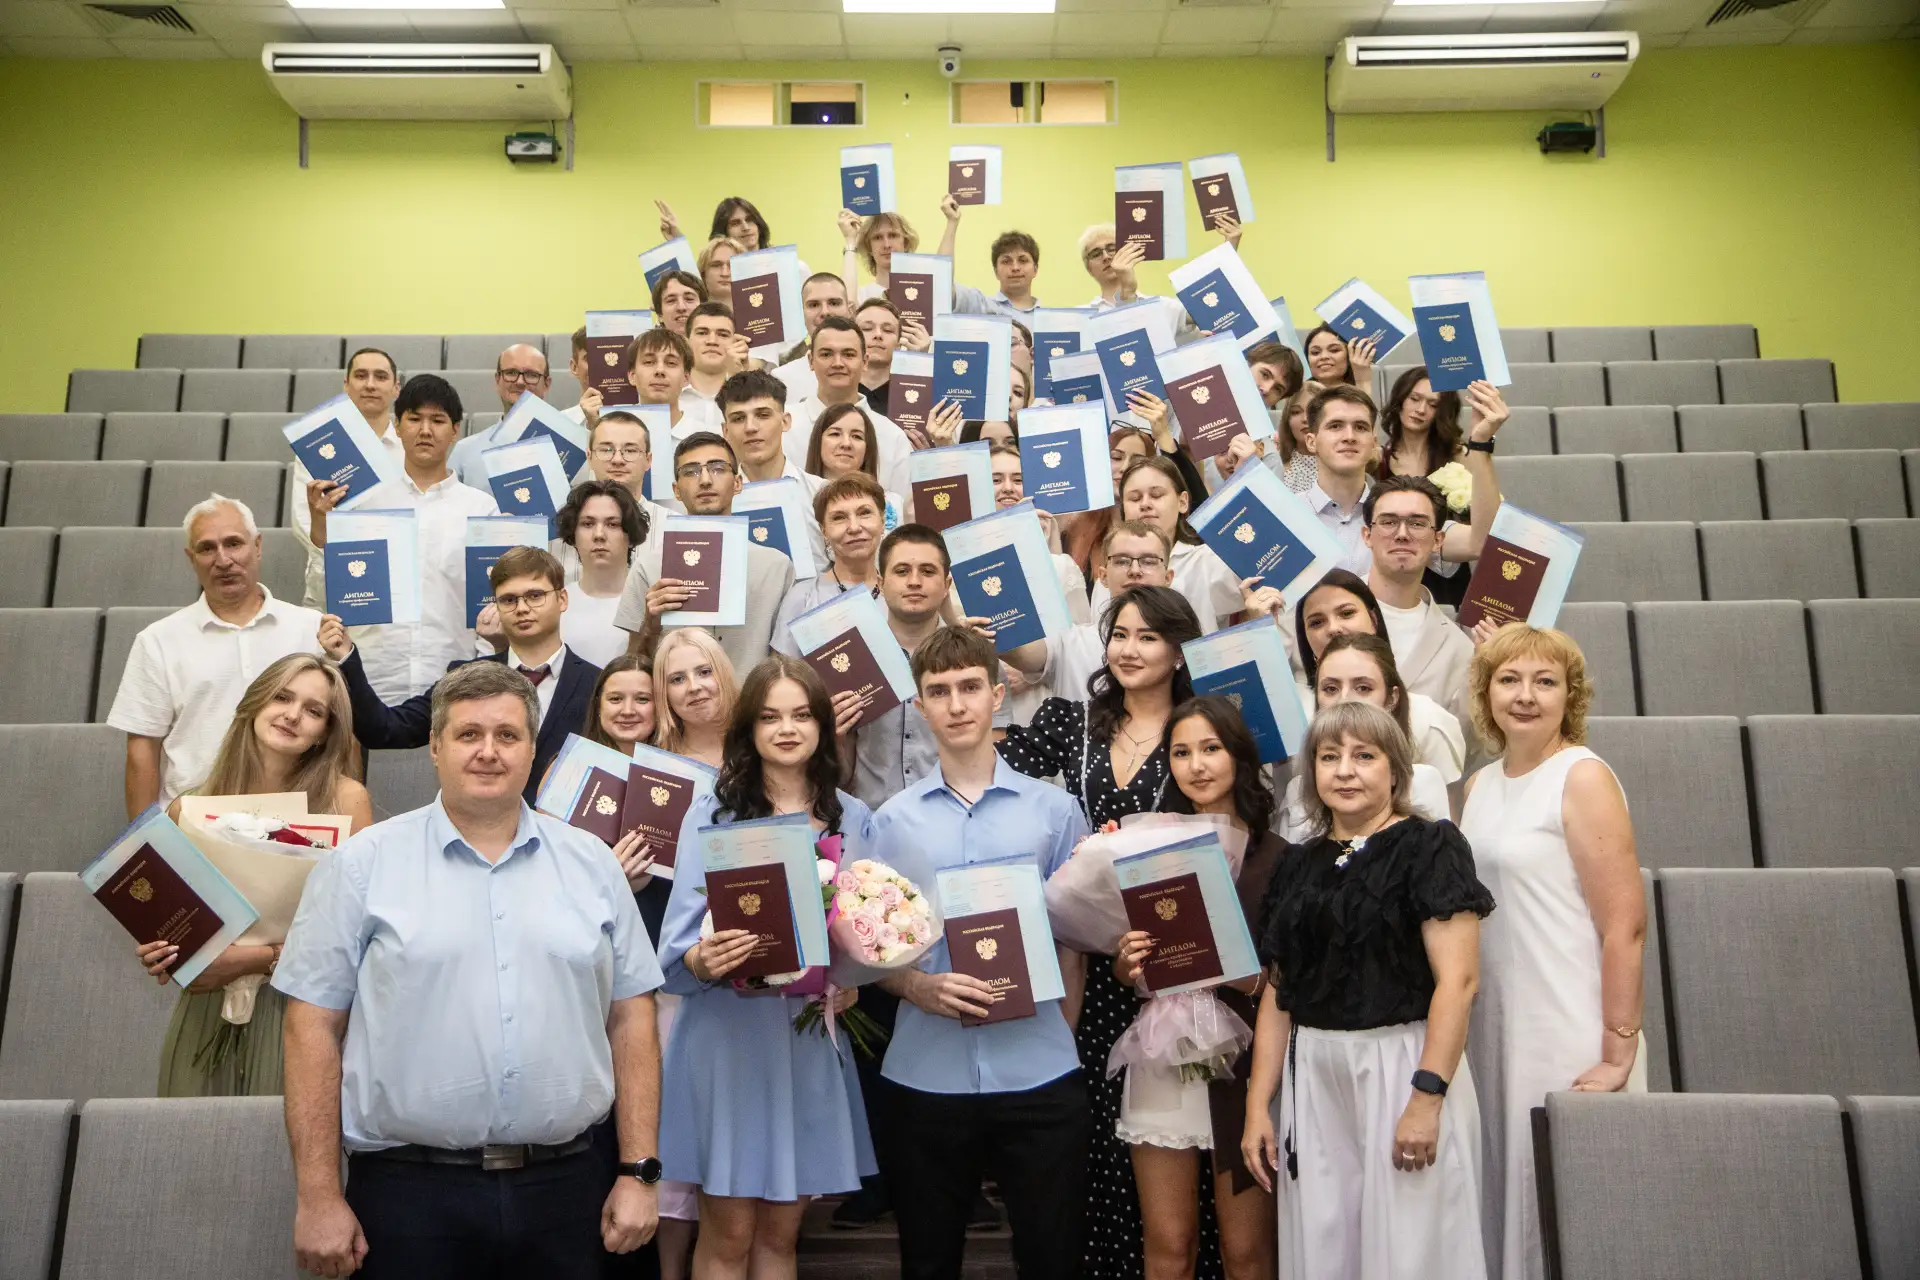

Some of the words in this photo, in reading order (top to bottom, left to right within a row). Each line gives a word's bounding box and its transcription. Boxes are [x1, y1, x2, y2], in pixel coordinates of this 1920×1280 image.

[747, 317, 770, 327] ДИПЛОМ
[1441, 355, 1467, 364] ДИПЛОМ
[1123, 374, 1148, 387] ДИПЛОМ
[1198, 417, 1228, 433] ДИПЛОМ
[331, 463, 353, 480] ДИПЛОМ
[1039, 480, 1070, 490] ДИПЛОМ
[1255, 543, 1281, 569] ДИПЛОМ
[344, 591, 375, 600] ДИПЛОМ
[1482, 596, 1514, 612] ДИПЛОМ
[853, 683, 874, 697] ПЛОМ
[637, 823, 672, 838] ДИПЛОМ
[156, 906, 187, 938] ДИПЛОМ
[1158, 941, 1196, 956] ДИПЛОМ
[984, 976, 1011, 986] ПЛОМ
